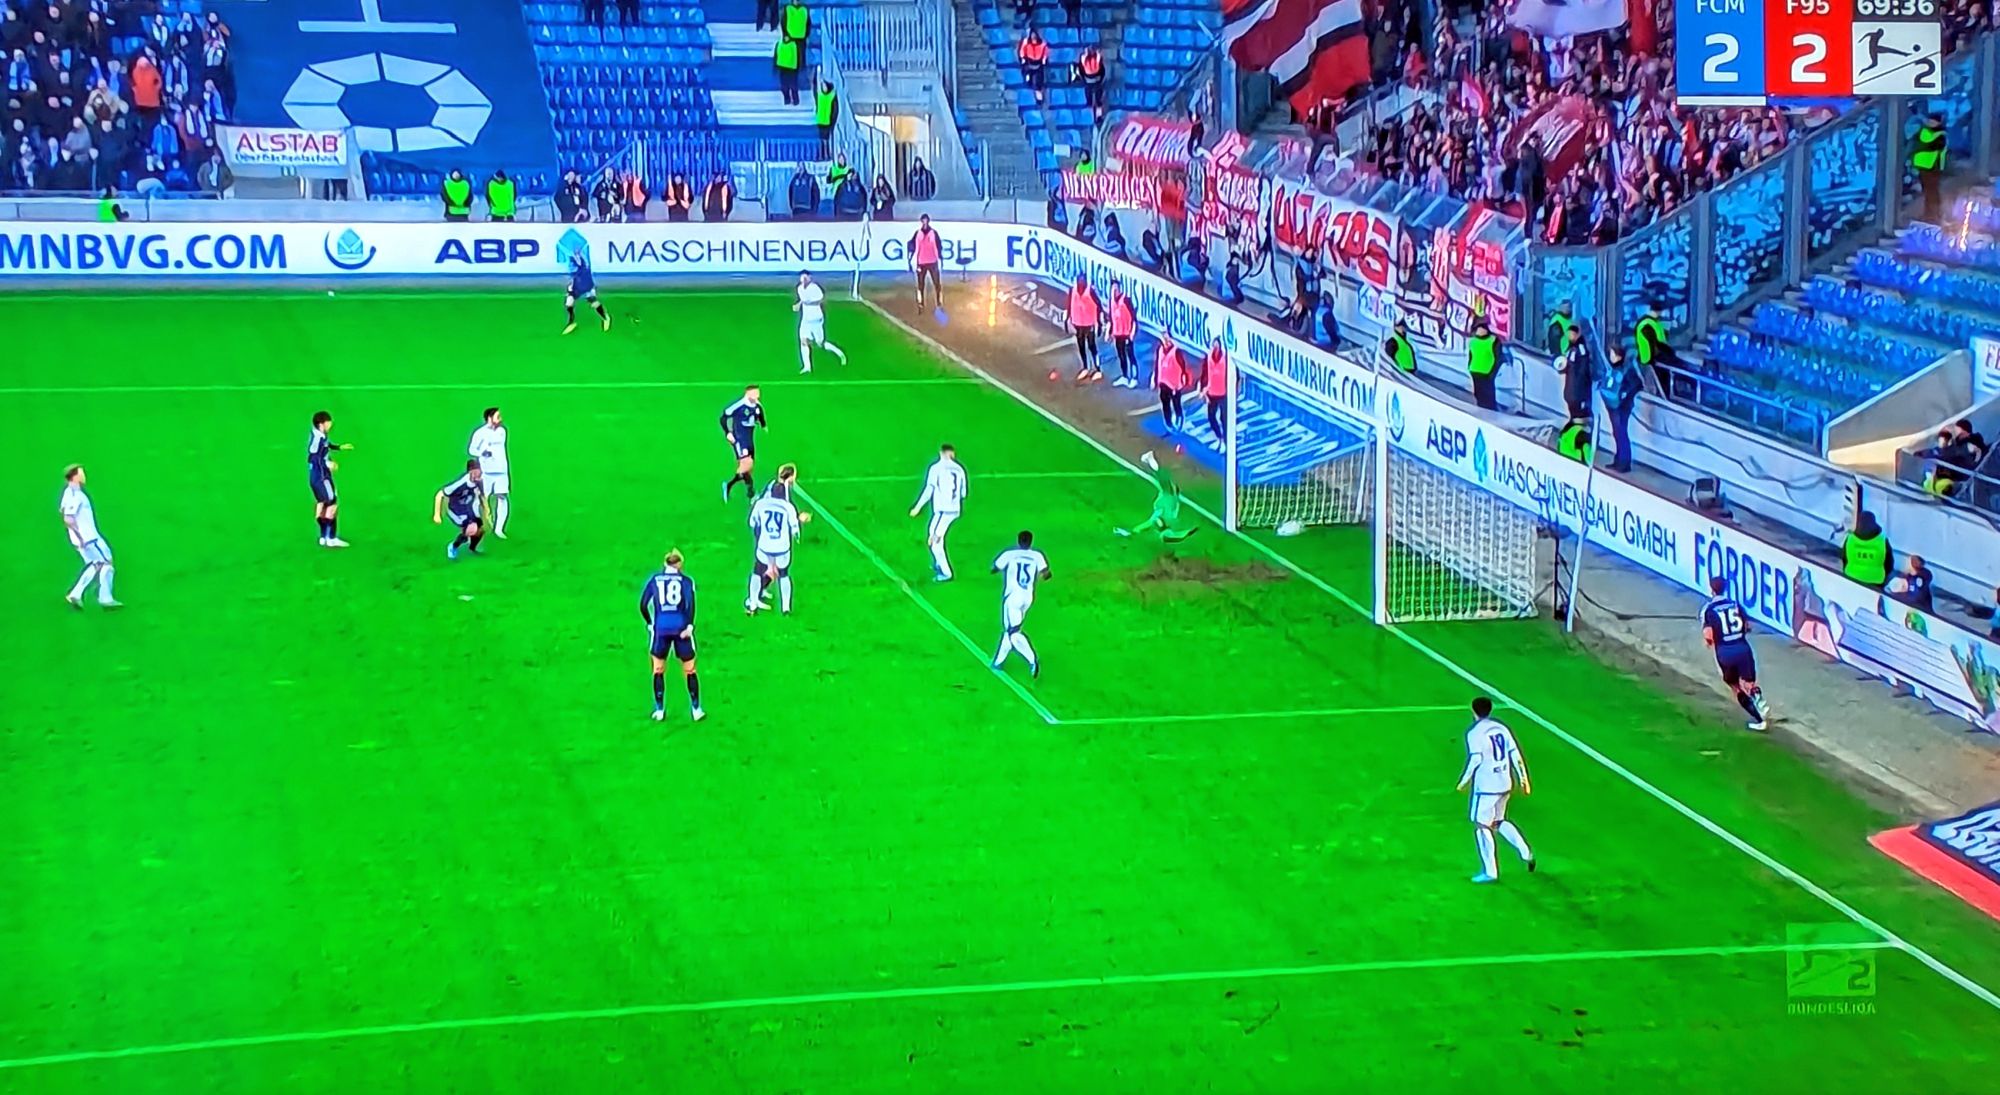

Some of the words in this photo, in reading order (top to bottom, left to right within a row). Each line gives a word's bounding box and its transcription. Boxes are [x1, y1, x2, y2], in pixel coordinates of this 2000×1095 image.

[236, 132, 340, 153] ALSTAB
[0, 234, 287, 269] MNBVG.COM
[434, 239, 540, 264] ABP
[608, 239, 871, 262] MASCHINENBAU
[882, 238, 977, 262] GBH
[1426, 418, 1467, 464] ABP
[1623, 510, 1677, 566] GMBH
[764, 510, 784, 533] 29
[1016, 562, 1031, 585] 15
[1694, 527, 1792, 628] FÖRDER
[656, 580, 682, 605] 18
[1717, 607, 1743, 635] 15
[1489, 733, 1505, 761] 19
